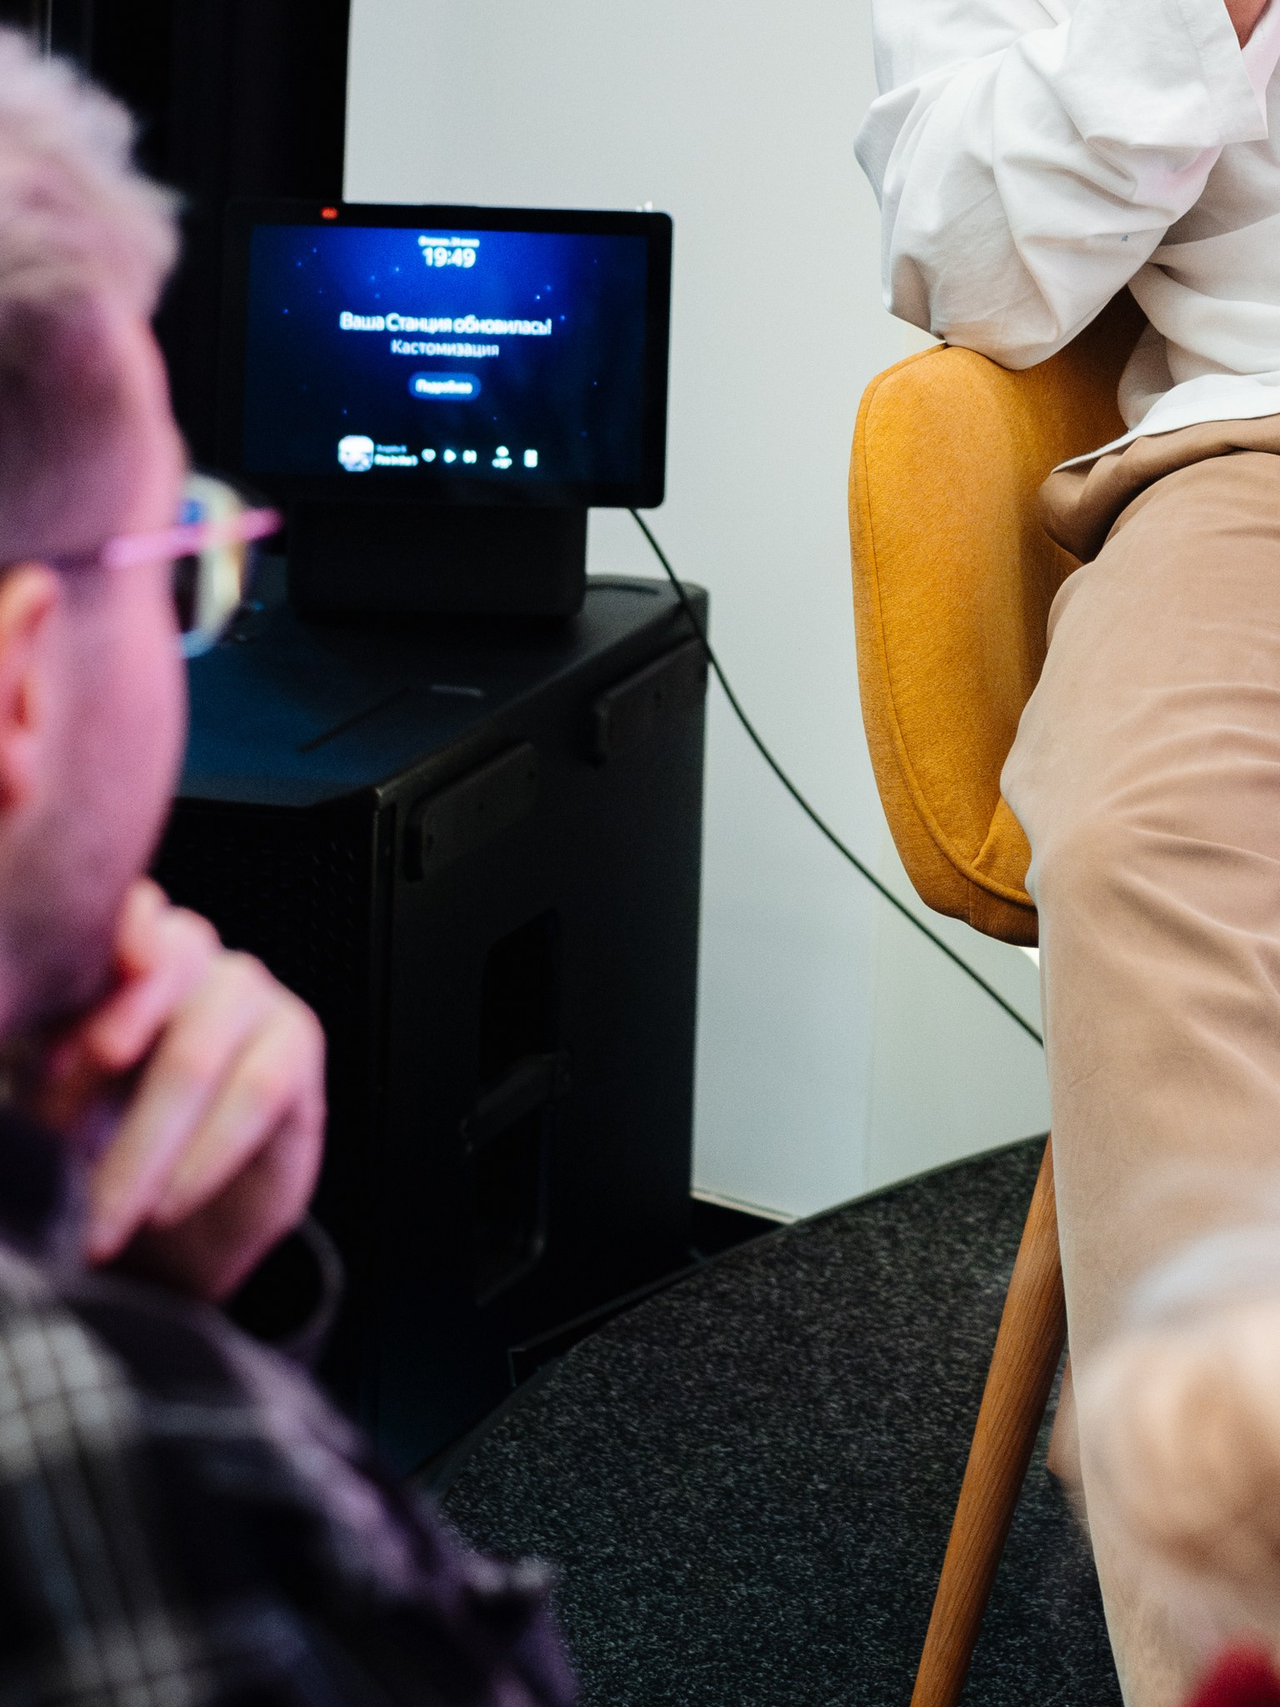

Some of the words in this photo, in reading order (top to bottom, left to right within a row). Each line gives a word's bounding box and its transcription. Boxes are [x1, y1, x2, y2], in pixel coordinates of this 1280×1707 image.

[422, 247, 476, 268] 19:49
[340, 311, 385, 331] Ваша
[386, 312, 452, 334] Станция
[453, 314, 552, 335] обновилась!
[390, 339, 500, 358] Кастомизация
